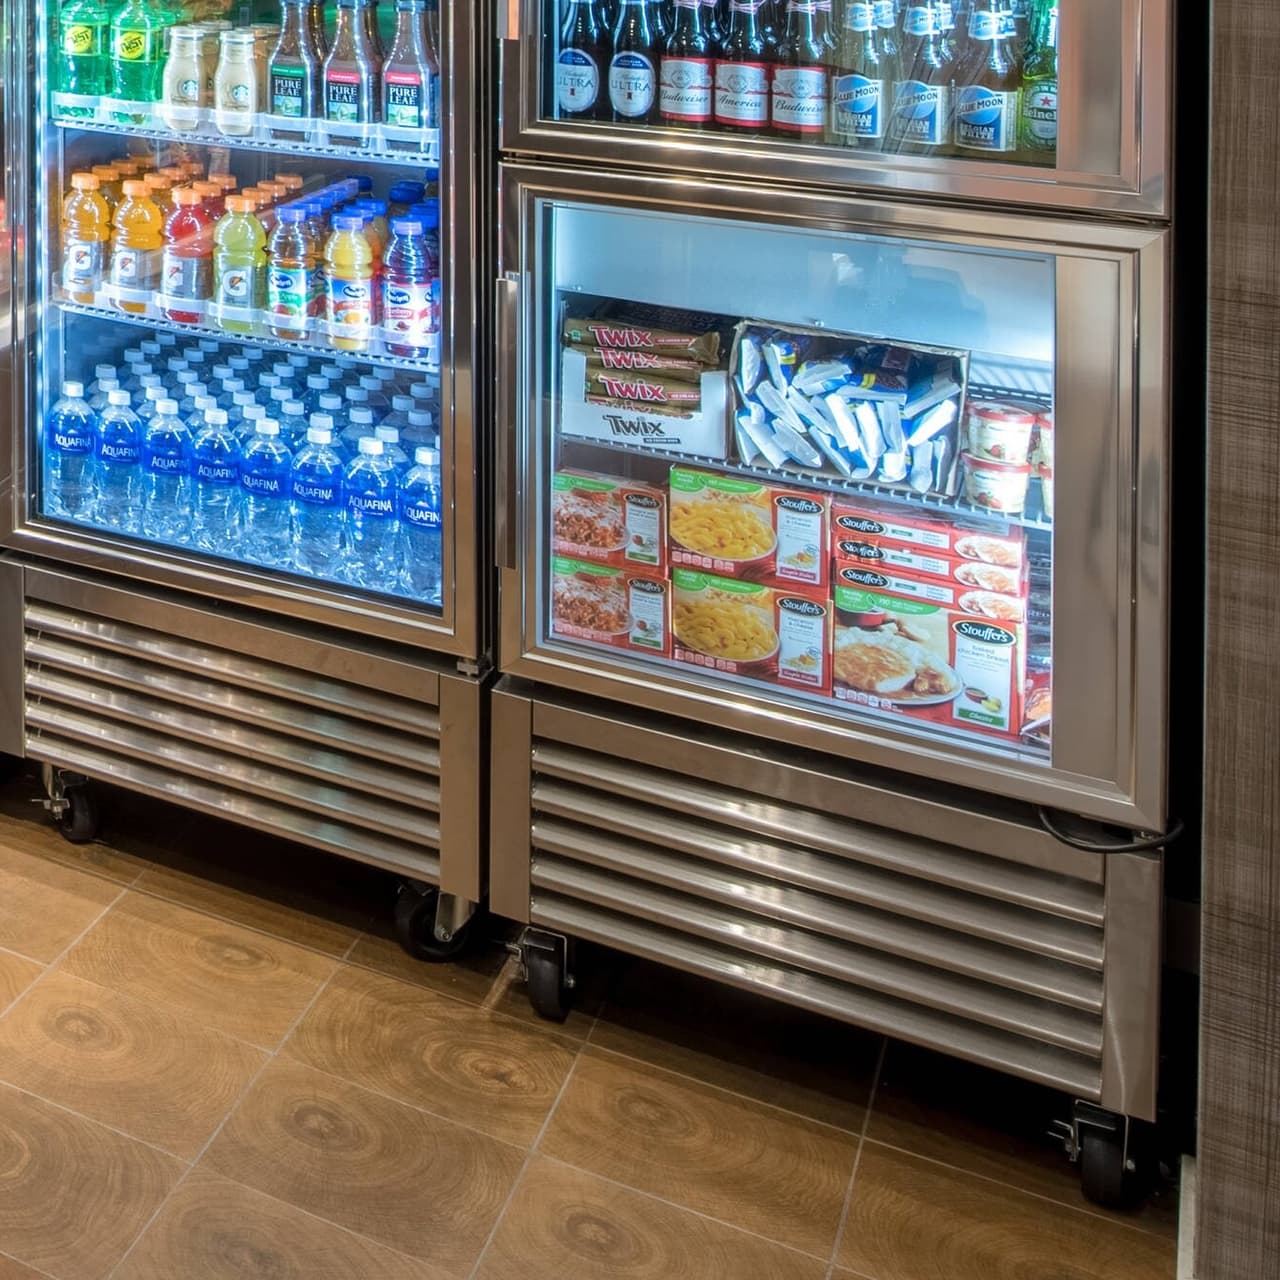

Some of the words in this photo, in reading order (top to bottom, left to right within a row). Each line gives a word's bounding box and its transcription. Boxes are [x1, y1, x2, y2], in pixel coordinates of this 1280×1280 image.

[275, 79, 301, 89] PURE
[329, 86, 357, 95] PURE
[612, 79, 650, 91] ULTRA
[390, 87, 417, 97] PURE
[855, 86, 880, 98] MOON
[912, 92, 938, 103] MOON
[717, 94, 763, 108] America
[976, 98, 1003, 109] MOON
[69, 245, 91, 270] G
[114, 252, 136, 277] G
[223, 271, 246, 296] G
[293, 483, 333, 500] AQUAFINA
[348, 495, 393, 513] AQUAFINA
[780, 497, 818, 513] Stouffer's
[842, 517, 879, 532] Stouffer's
[846, 570, 884, 586] Stouffer's
[782, 600, 821, 614] Stouffer's
[961, 622, 1008, 642] Stouffer's
